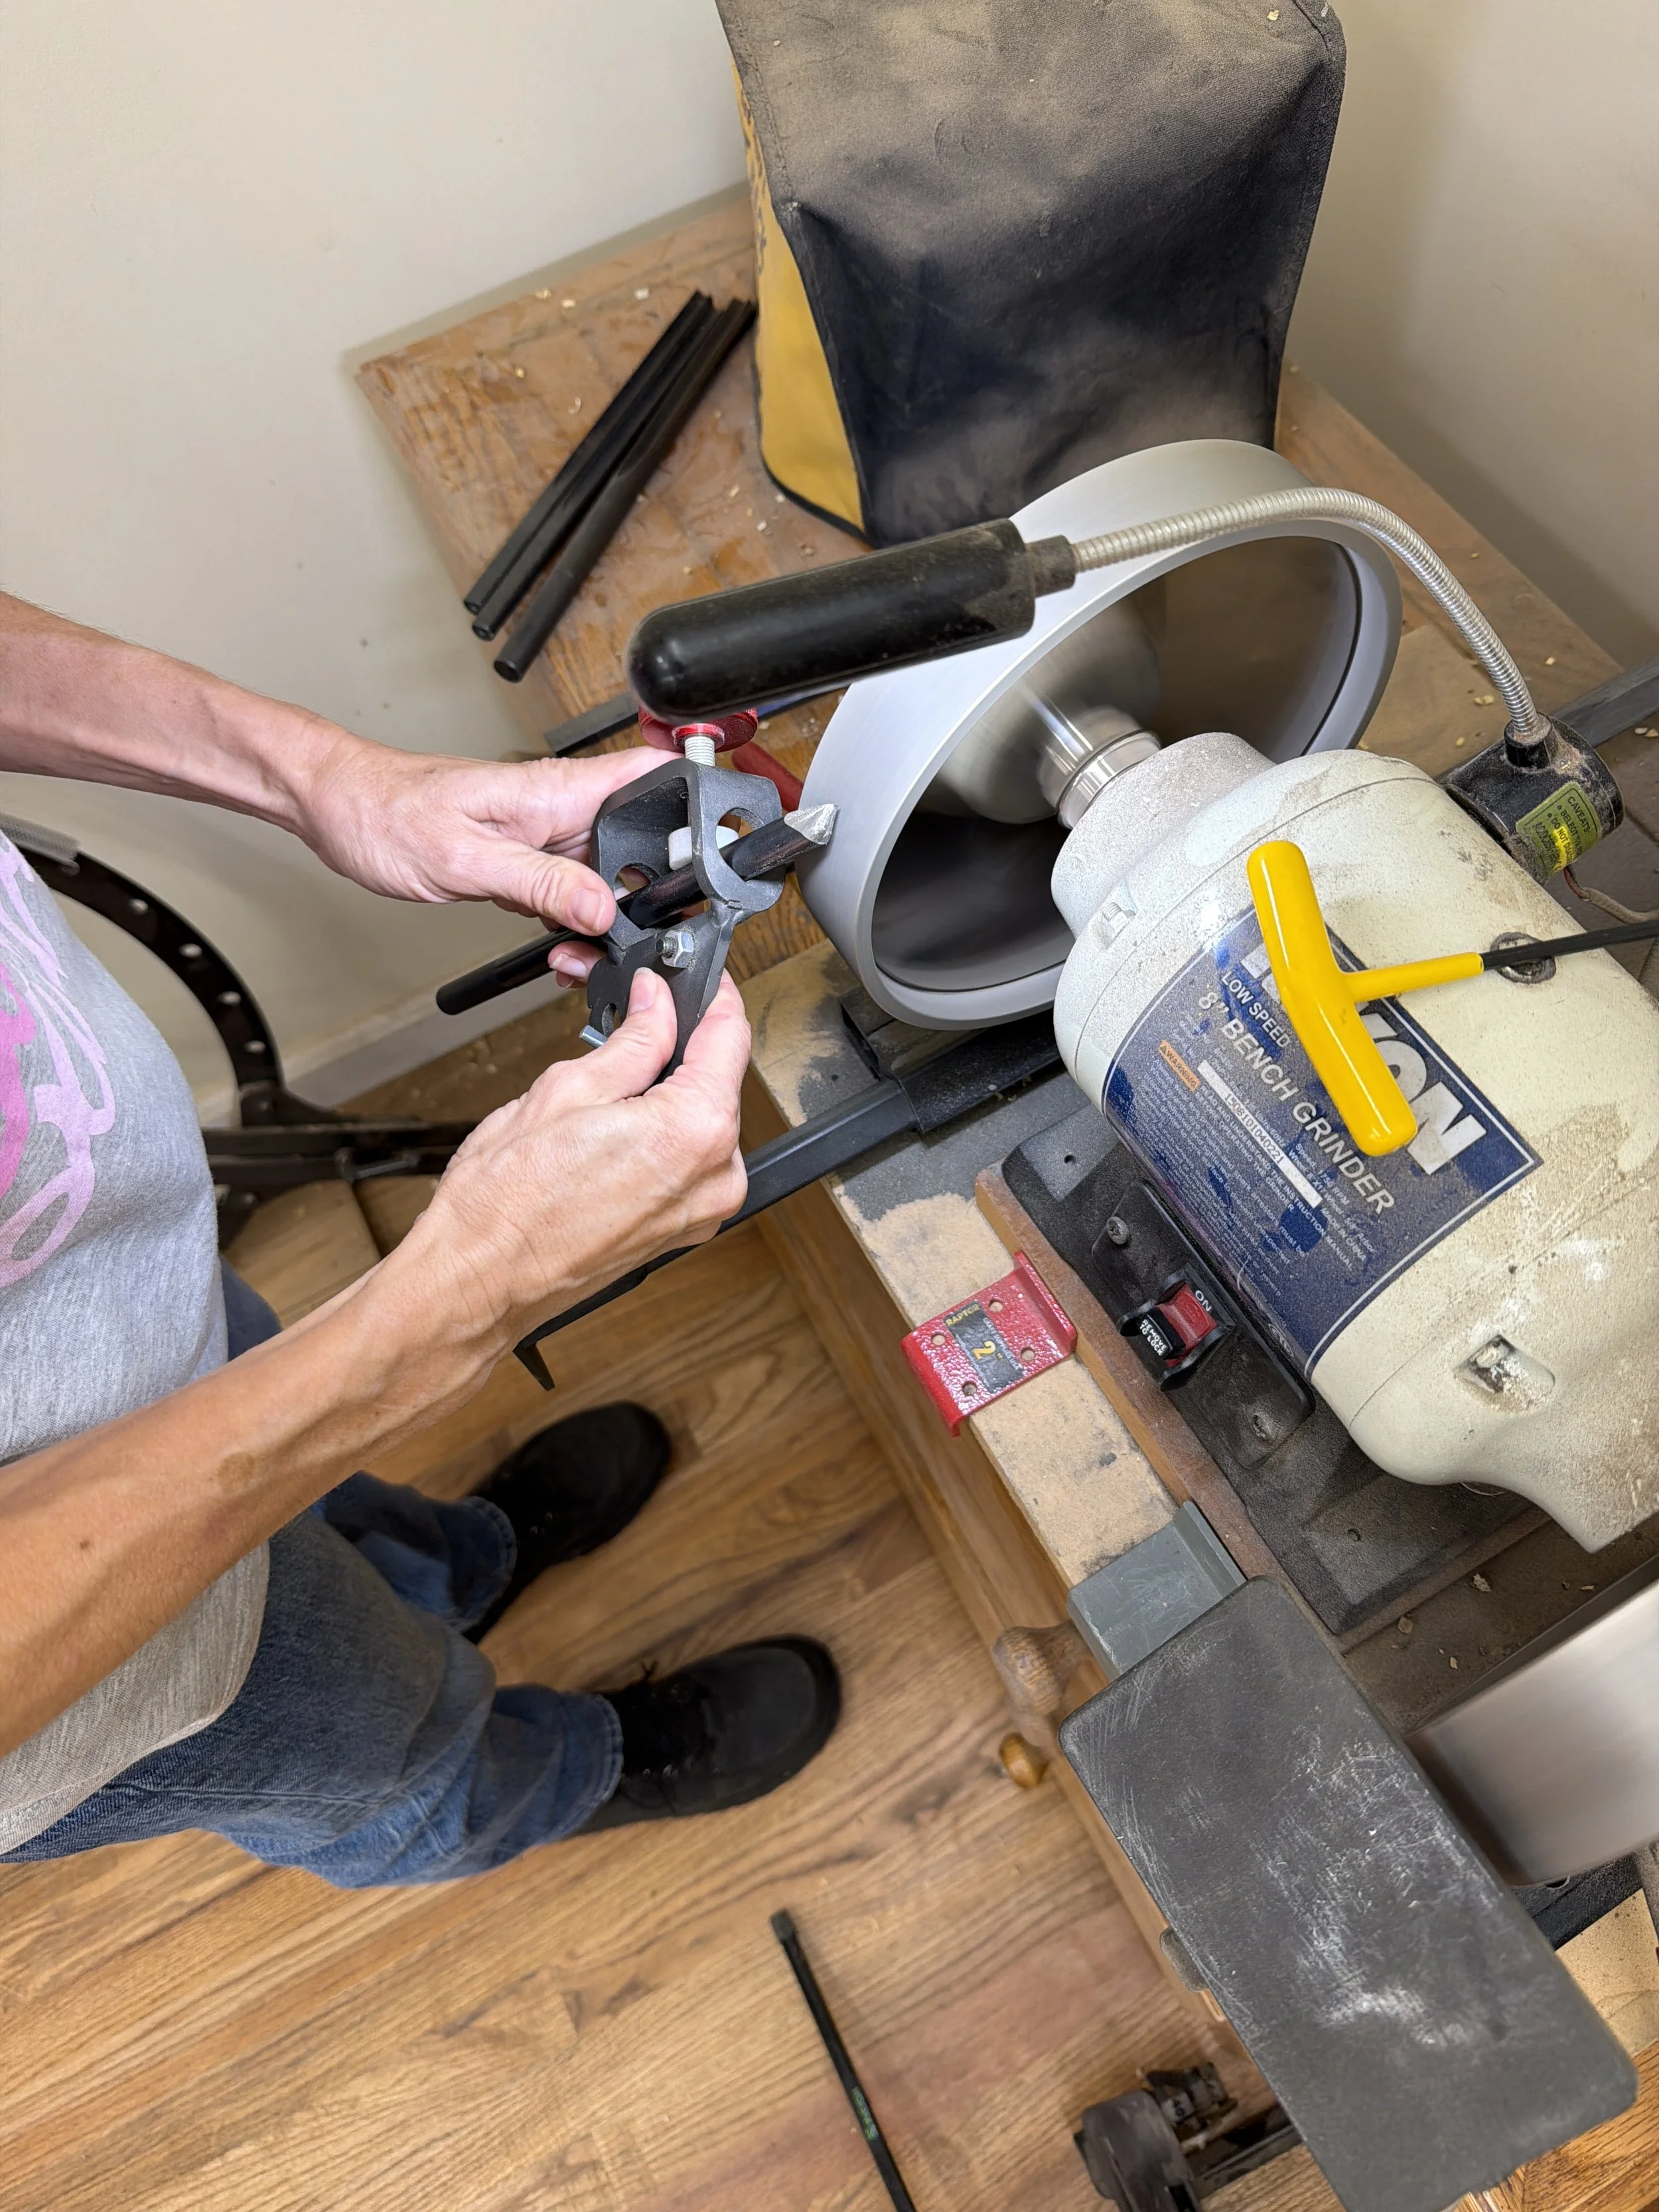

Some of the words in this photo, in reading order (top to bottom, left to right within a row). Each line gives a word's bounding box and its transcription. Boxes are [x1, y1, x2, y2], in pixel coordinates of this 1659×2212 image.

[1550, 817, 1561, 830] DO
[1565, 795, 1593, 834] CAVEATS:
[1555, 828, 1569, 844] NOT
[1220, 970, 1253, 1006] LOW
[1247, 1000, 1292, 1051] SPEED
[1164, 1049, 1198, 1090] WARNING
[1220, 1015, 1300, 1104] BENCH
[1290, 1096, 1396, 1217] GRINDER
[1222, 1092, 1285, 1165] 1508101040221
[1193, 1091, 1222, 1124] BEFORE
[1217, 1120, 1256, 1163] OPERATING
[1251, 1160, 1268, 1179] THE
[1198, 1085, 1220, 1109] READ
[1215, 1104, 1232, 1123] AND
[1228, 1120, 1272, 1171] UNDERSTAND
[1269, 1168, 1285, 1187] THE
[1282, 1184, 1327, 1236] INSTRUCTION
[1324, 1234, 1354, 1270] MANUAL
[1200, 1155, 1226, 1185] surface
[1222, 1181, 1234, 1193] to
[1331, 1185, 1350, 1206] RPM
[1278, 1224, 1298, 1247] must
[1294, 1244, 1307, 1258] be
[1344, 1236, 1367, 1261] CHINA
[944, 1302, 981, 1328] RAPTOR
[1193, 1288, 1213, 1312] ON
[992, 1333, 1013, 1361] SUPPLIES
[1009, 1357, 1020, 1370] USA
[1137, 1323, 1148, 1335] TO
[1146, 1335, 1164, 1357] LOCK
[1141, 1317, 1168, 1352] REMOVE
